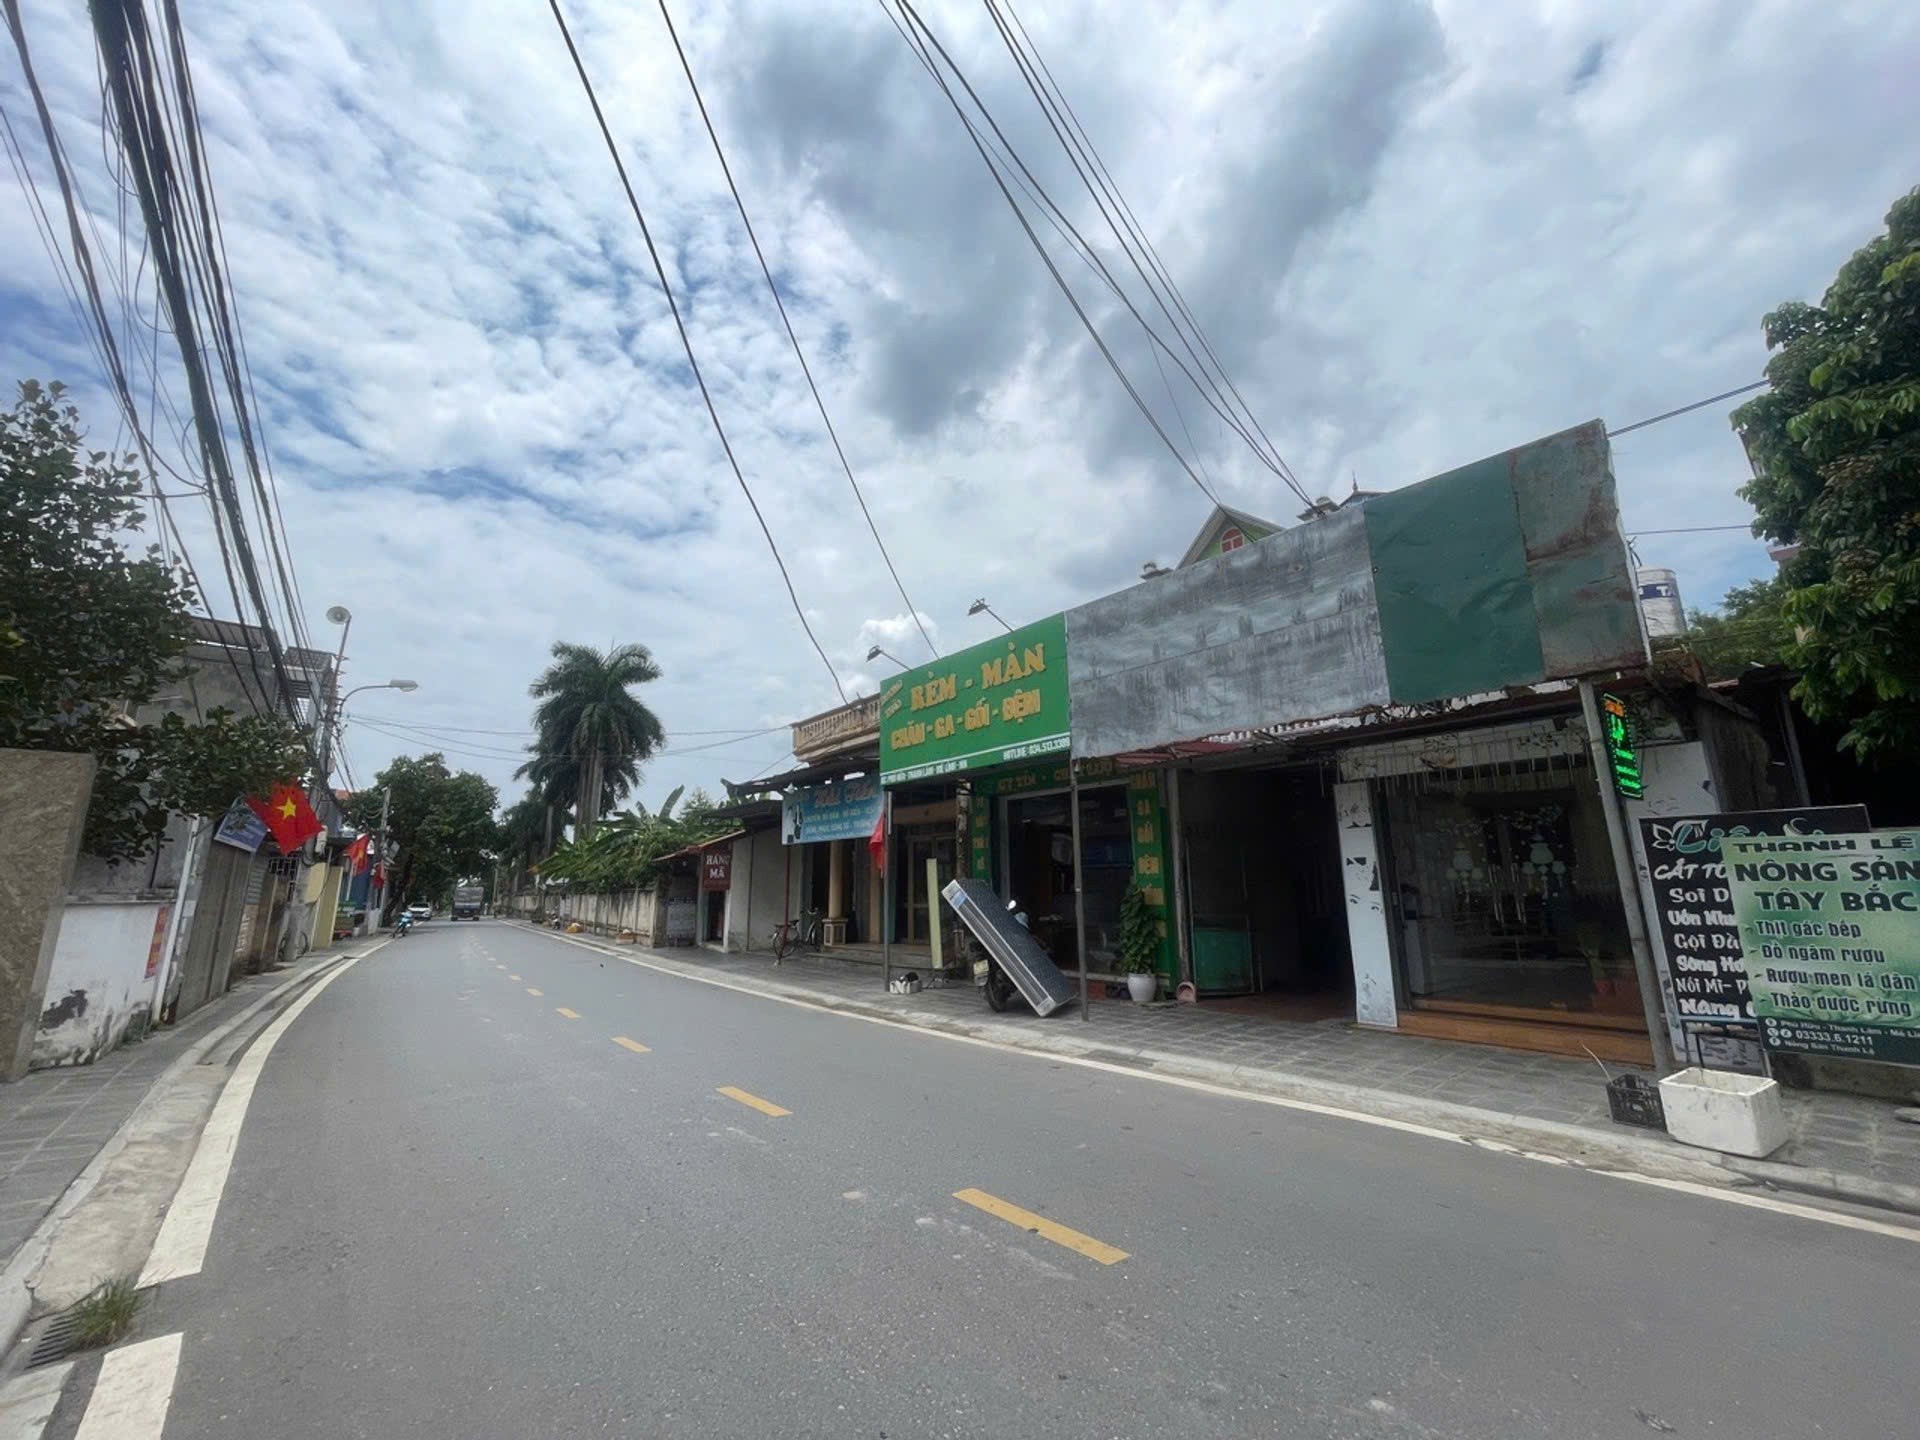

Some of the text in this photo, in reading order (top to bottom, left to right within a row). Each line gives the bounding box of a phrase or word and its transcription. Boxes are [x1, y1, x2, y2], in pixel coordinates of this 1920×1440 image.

[911, 671, 956, 711] RÈM
[891, 688, 1041, 750] CHĂN GA GỐI ĐỆM
[1733, 836, 1914, 853] THANH LỆ
[1734, 855, 1920, 882] NÔNG SẢN
[1754, 883, 1918, 912] TÂY BẮC
[1756, 920, 1861, 938] Thịt gác bếp
[1762, 943, 1885, 966] Đồ ngâm rượu
[1766, 968, 1809, 987] Rượu
[1814, 972, 1852, 986] men
[1857, 972, 1874, 988] lá
[1771, 991, 1811, 1009] Thảo
[1867, 998, 1912, 1017] rừng
